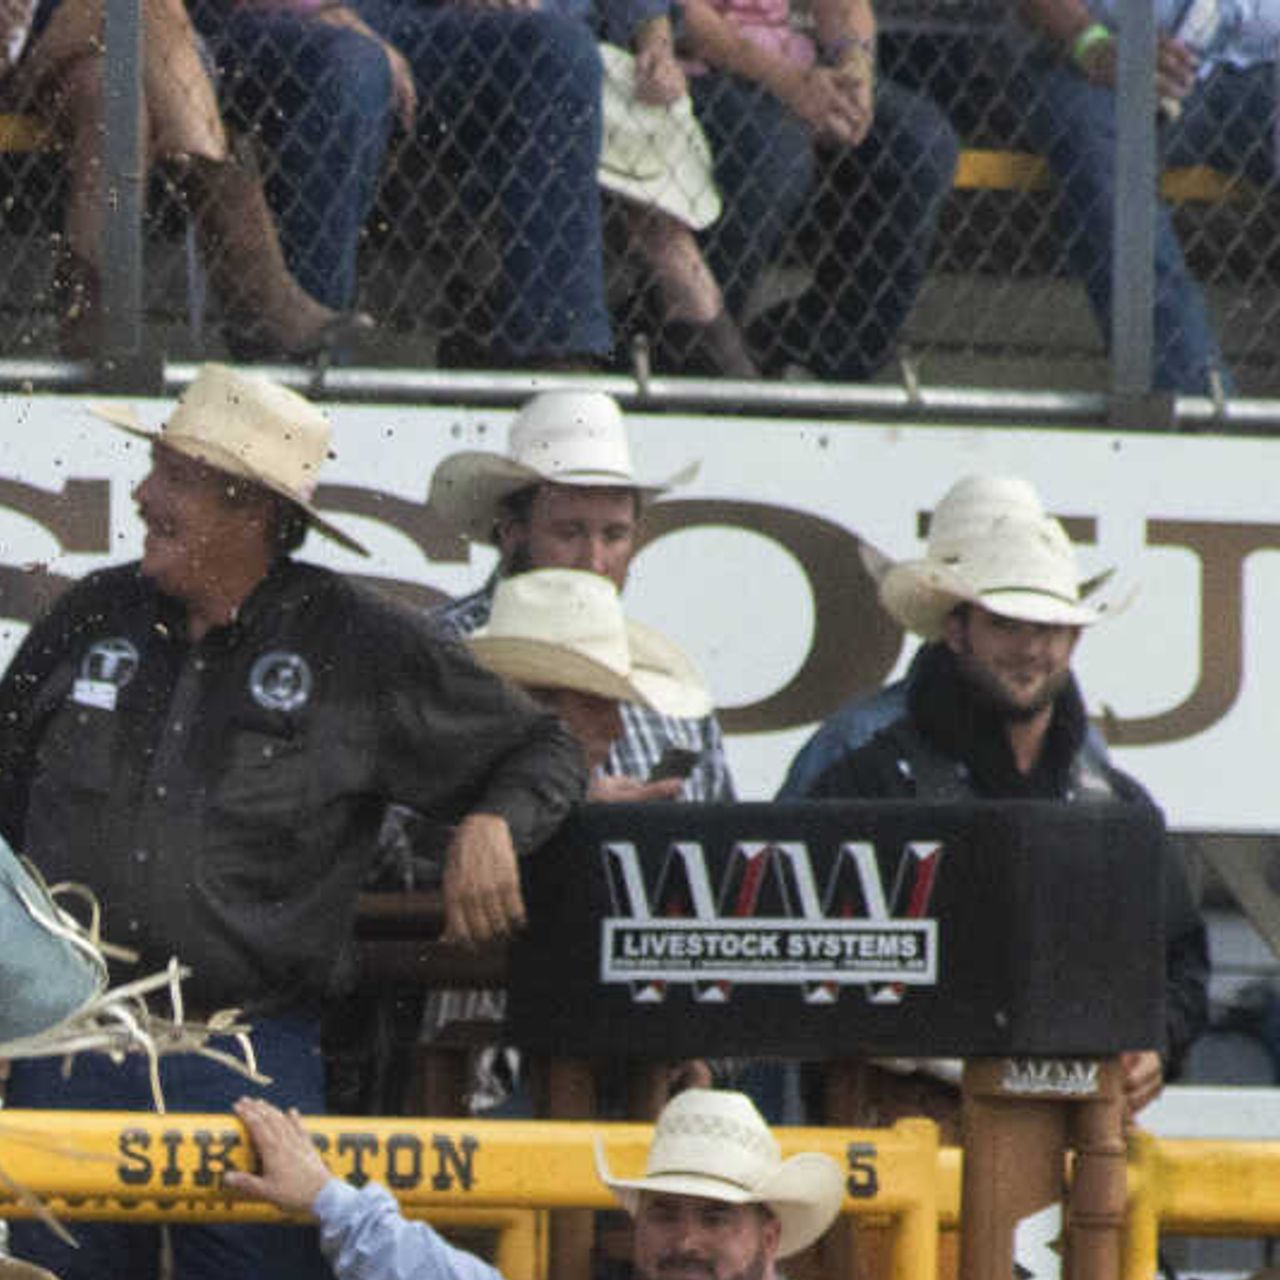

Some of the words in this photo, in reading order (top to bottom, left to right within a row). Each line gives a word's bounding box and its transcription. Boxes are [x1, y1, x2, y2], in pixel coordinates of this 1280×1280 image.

[623, 932, 781, 957] LIVESTOCK
[785, 934, 918, 958] SYSTEMS
[118, 1126, 480, 1191] SIKTON
[844, 1143, 879, 1199] 5
